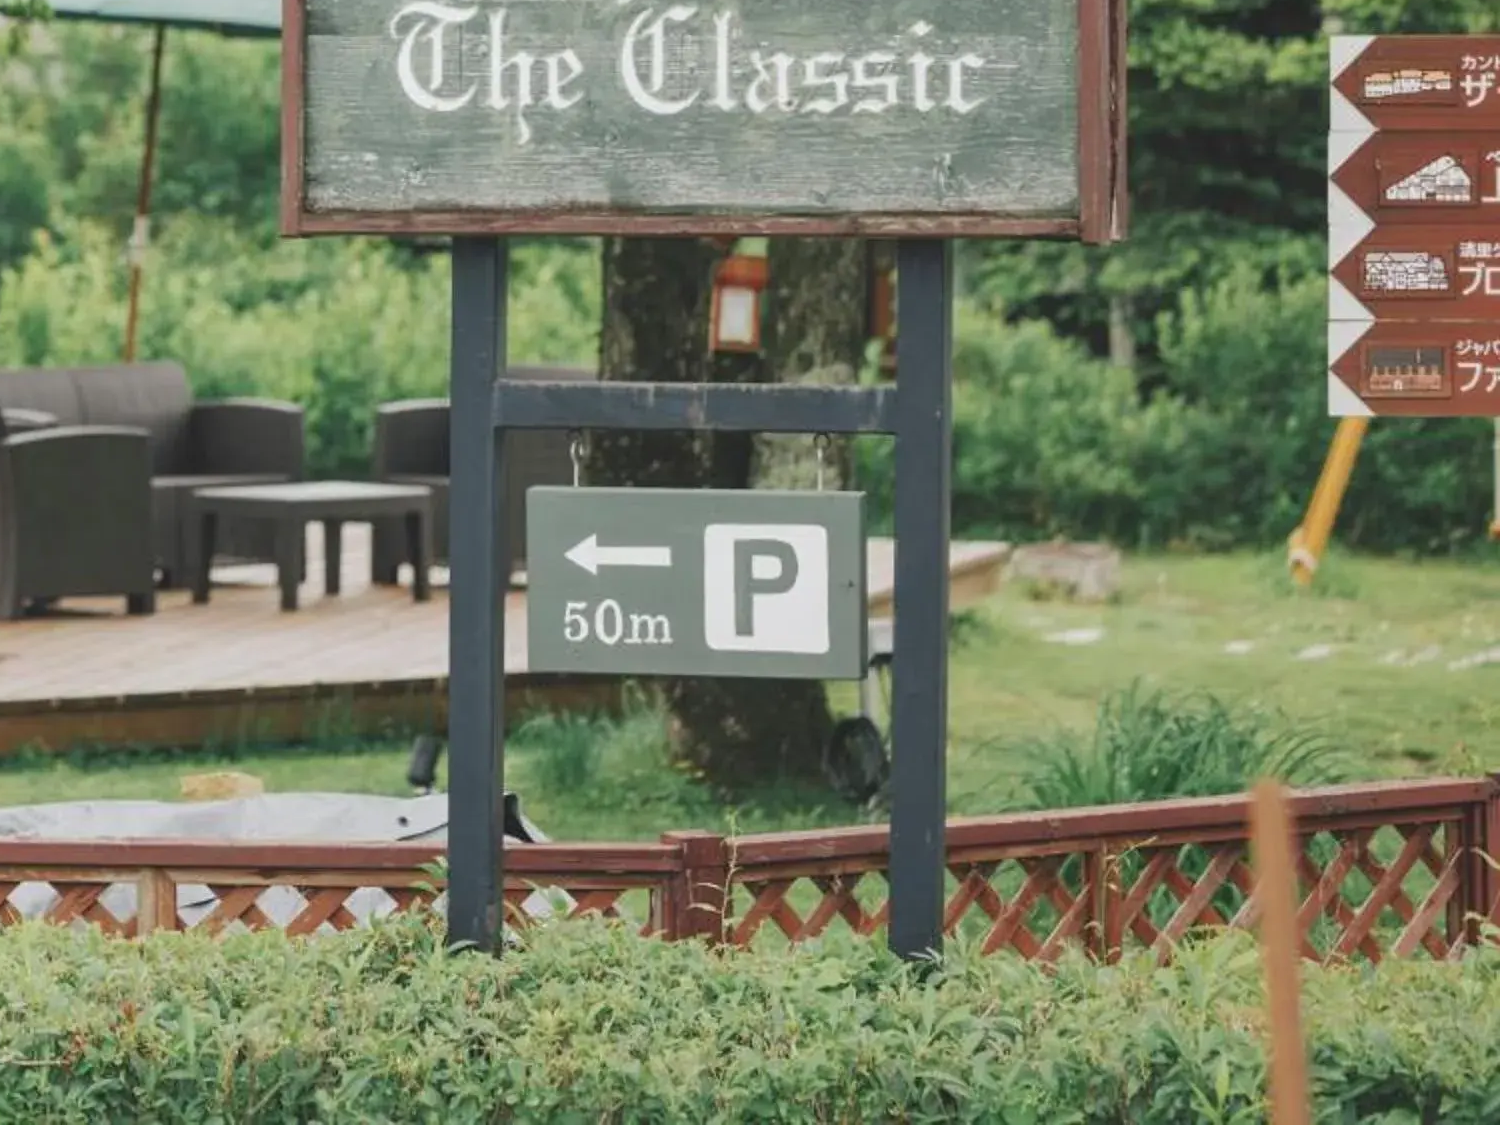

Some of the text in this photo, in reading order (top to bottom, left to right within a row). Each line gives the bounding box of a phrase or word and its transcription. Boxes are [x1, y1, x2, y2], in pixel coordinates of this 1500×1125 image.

[389, 1, 989, 145] The Classic
[563, 538, 799, 646] 50m P
